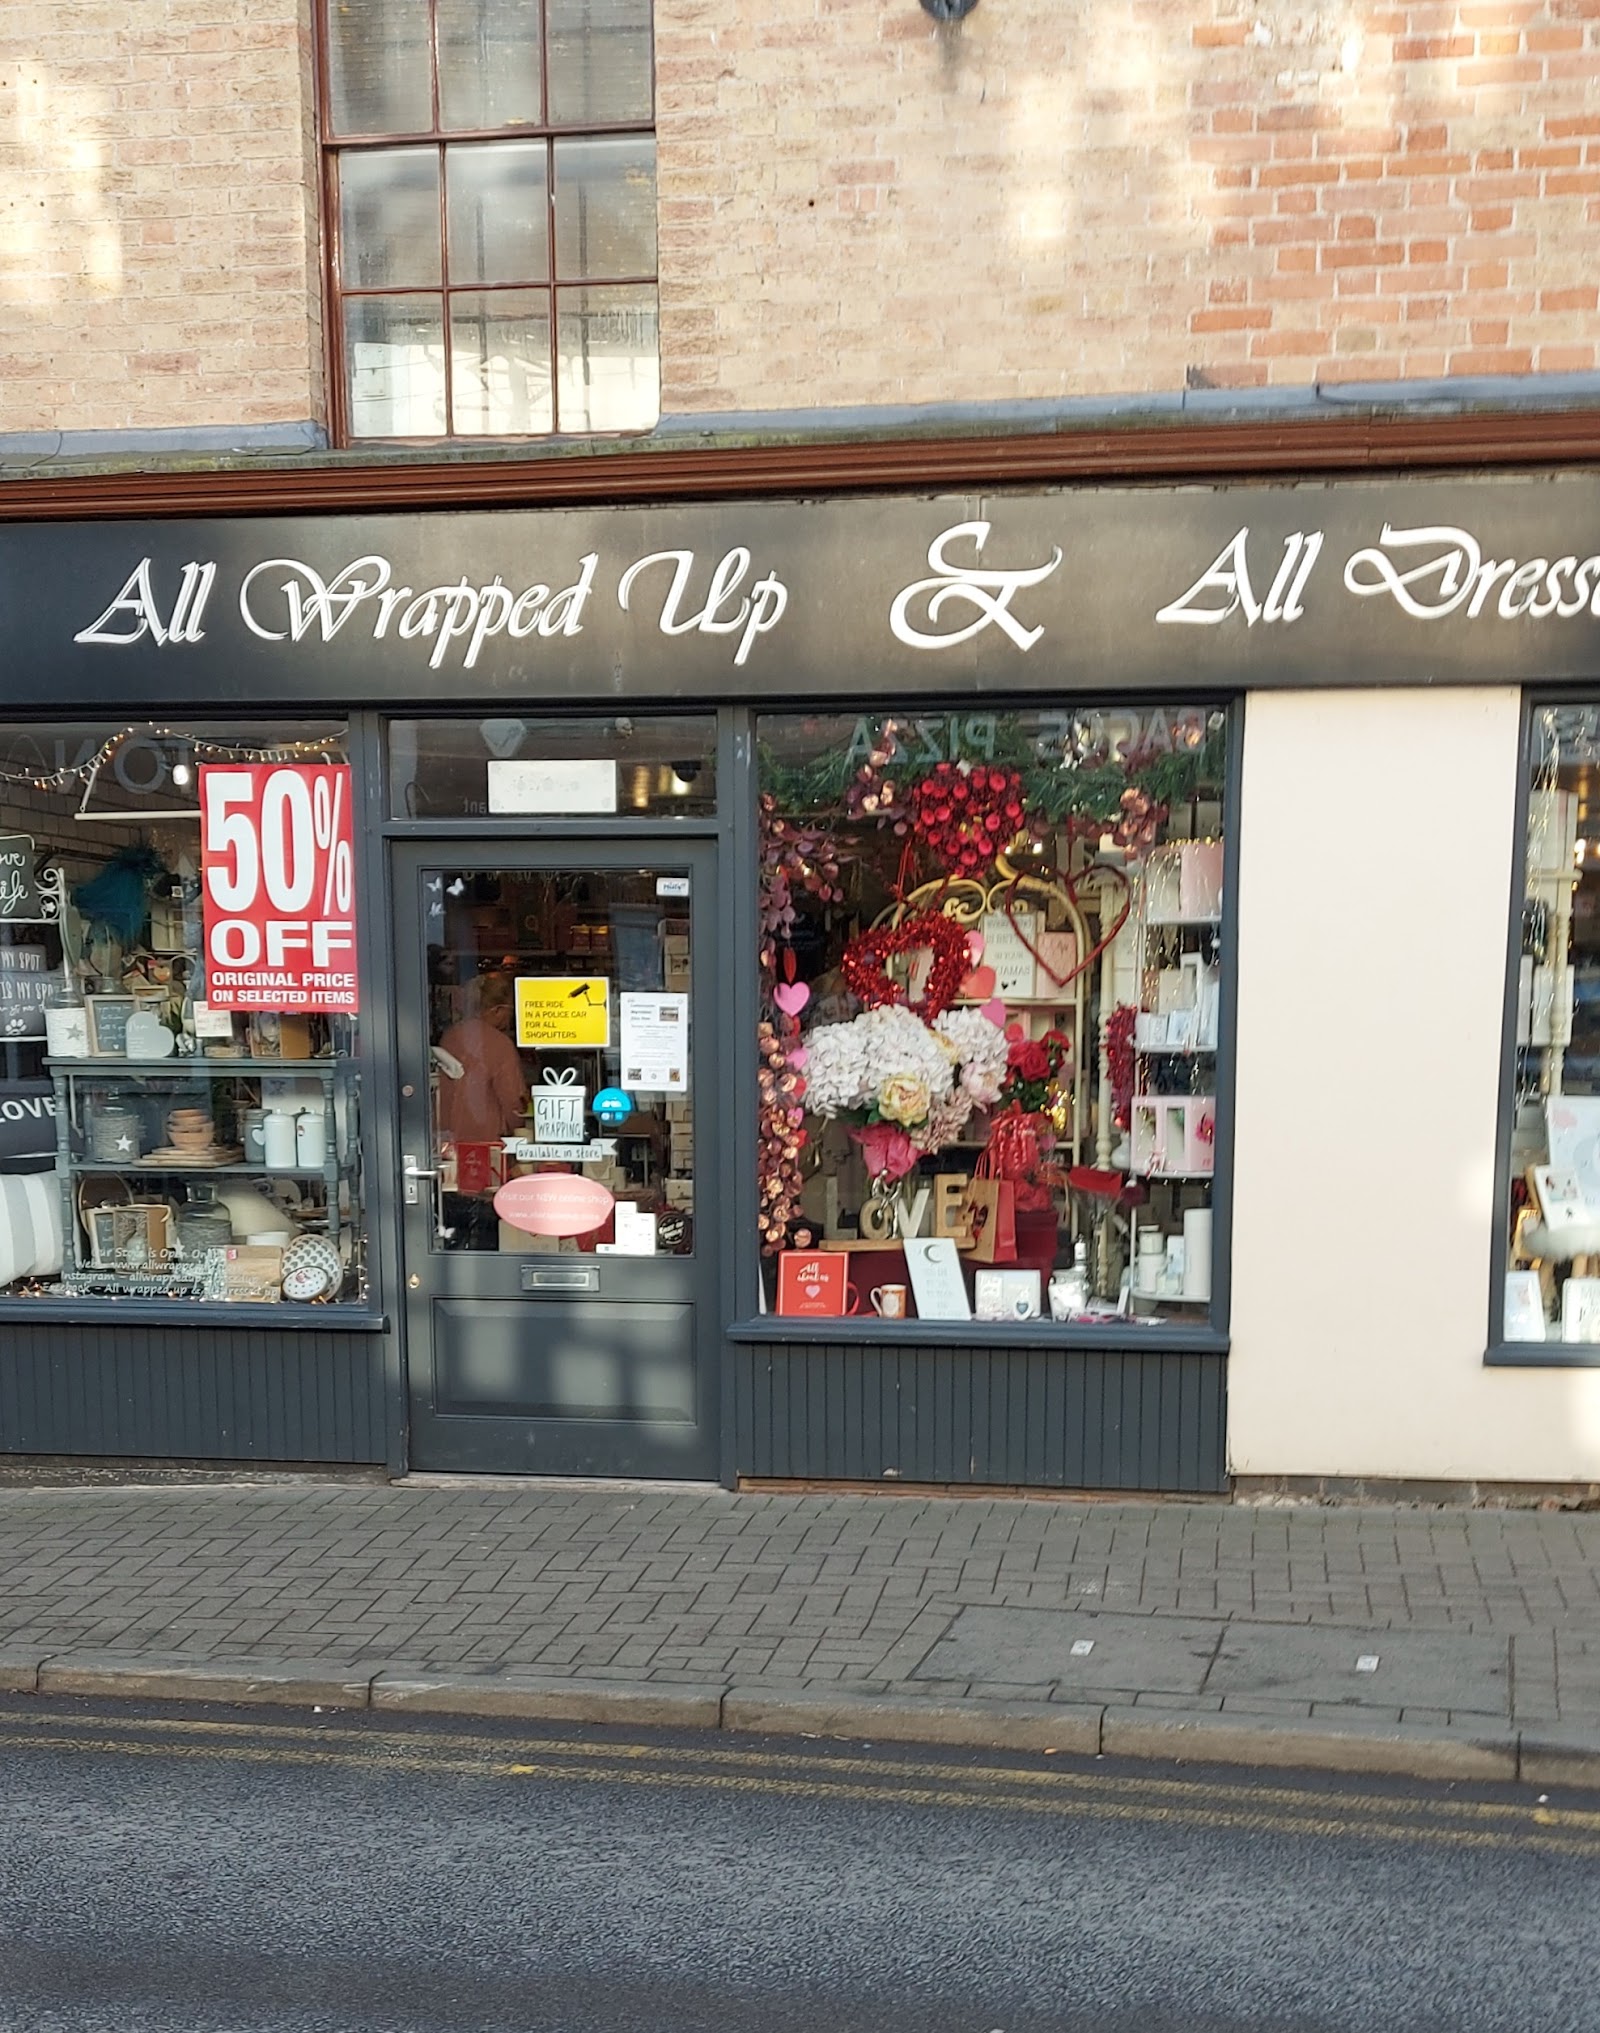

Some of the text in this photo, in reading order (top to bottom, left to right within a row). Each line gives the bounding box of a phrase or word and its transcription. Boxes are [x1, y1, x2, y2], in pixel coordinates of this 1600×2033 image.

[74, 520, 1600, 669] All Wrapped Up & All Dress
[205, 769, 351, 916] 50%
[210, 919, 353, 967] OFF
[1, 950, 41, 971] MY SPOT
[212, 971, 355, 988] ORIGINAL PRICE
[16, 981, 31, 1000] MY
[35, 982, 55, 1001] SPO
[212, 989, 355, 1005] ON SELECTED ITEMS
[525, 1000, 565, 1008] FREE RIDE
[525, 1010, 587, 1019] IN A POLICE CAR
[525, 1021, 557, 1029] FOR ALL
[525, 1031, 577, 1039] SHOPLIFTERS
[0, 1096, 56, 1124] OVE
[537, 1098, 580, 1122] GIFT
[537, 1121, 580, 1139] WRAPPING
[518, 1147, 600, 1159] available in store
[826, 1173, 973, 1240] LOVE
[61, 1271, 115, 1283] Instagram
[104, 1282, 119, 1293] All
[123, 1284, 169, 1297] wrapped
[173, 1286, 188, 1297] up
